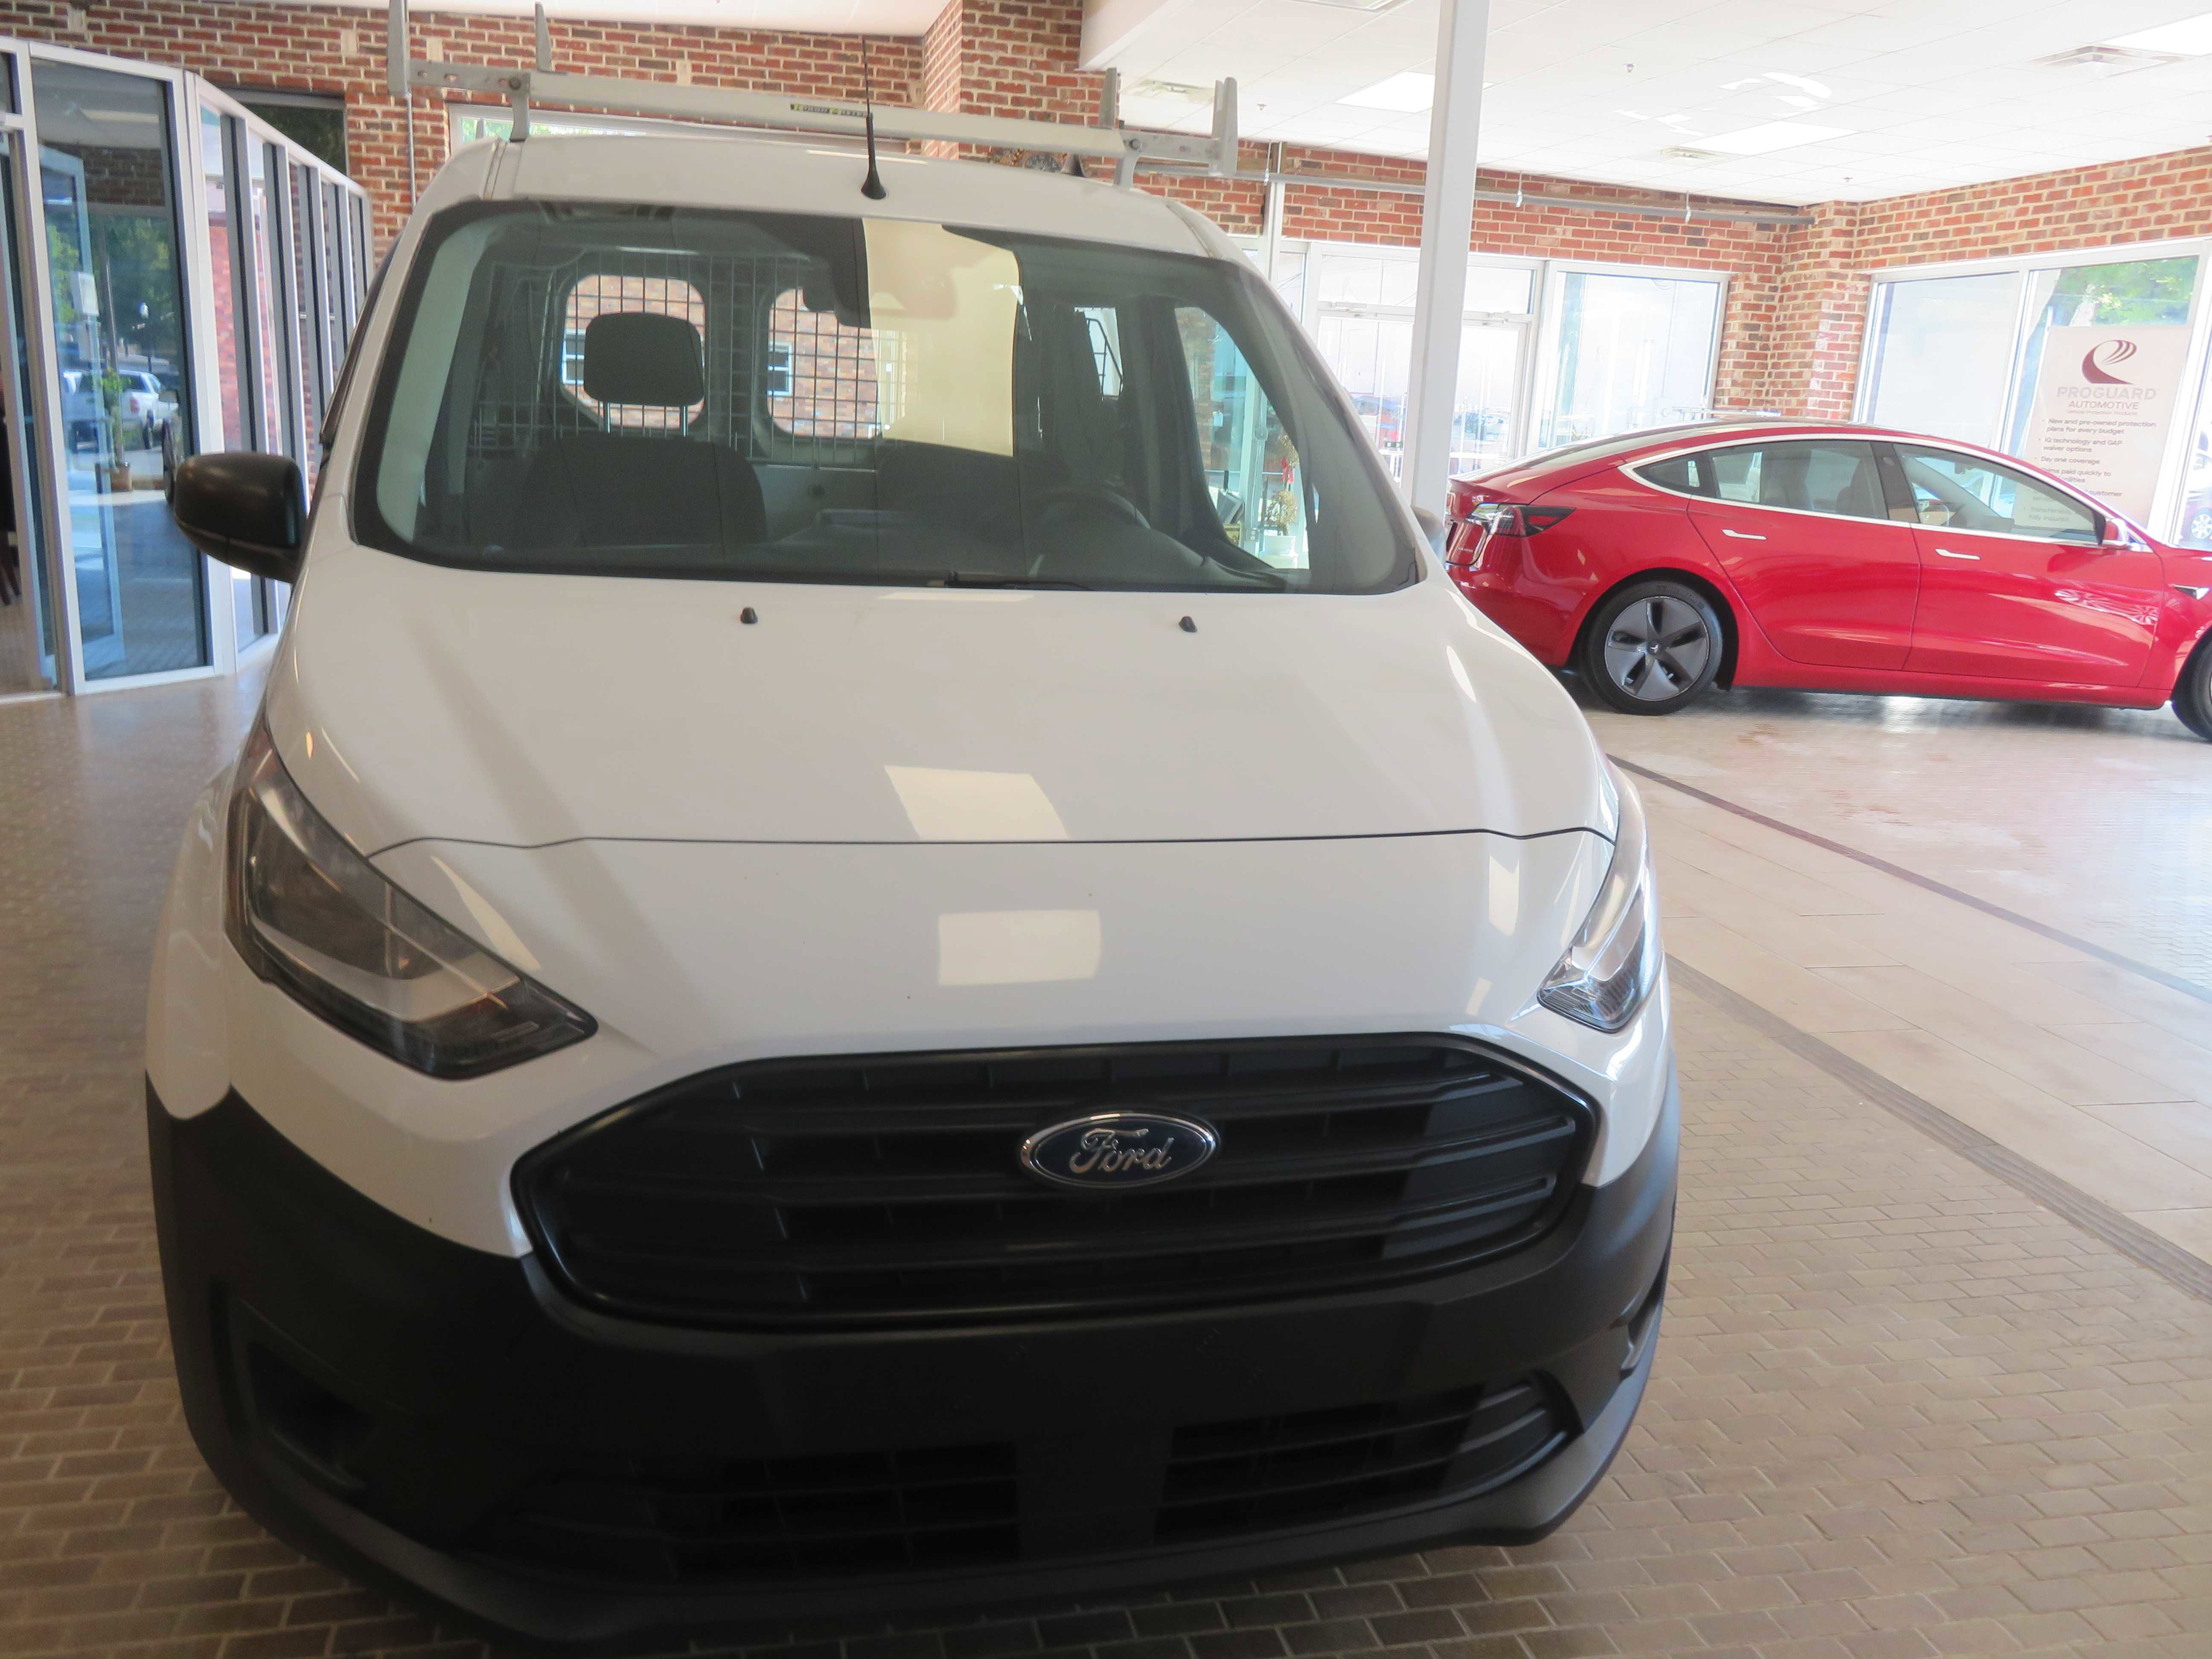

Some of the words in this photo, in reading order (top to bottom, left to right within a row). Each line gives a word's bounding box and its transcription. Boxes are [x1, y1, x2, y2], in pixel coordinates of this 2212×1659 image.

[2056, 386, 2157, 400] PROGUARD
[2068, 400, 2139, 410] AUTOMOTIVE
[1069, 1127, 1175, 1174] Ford
